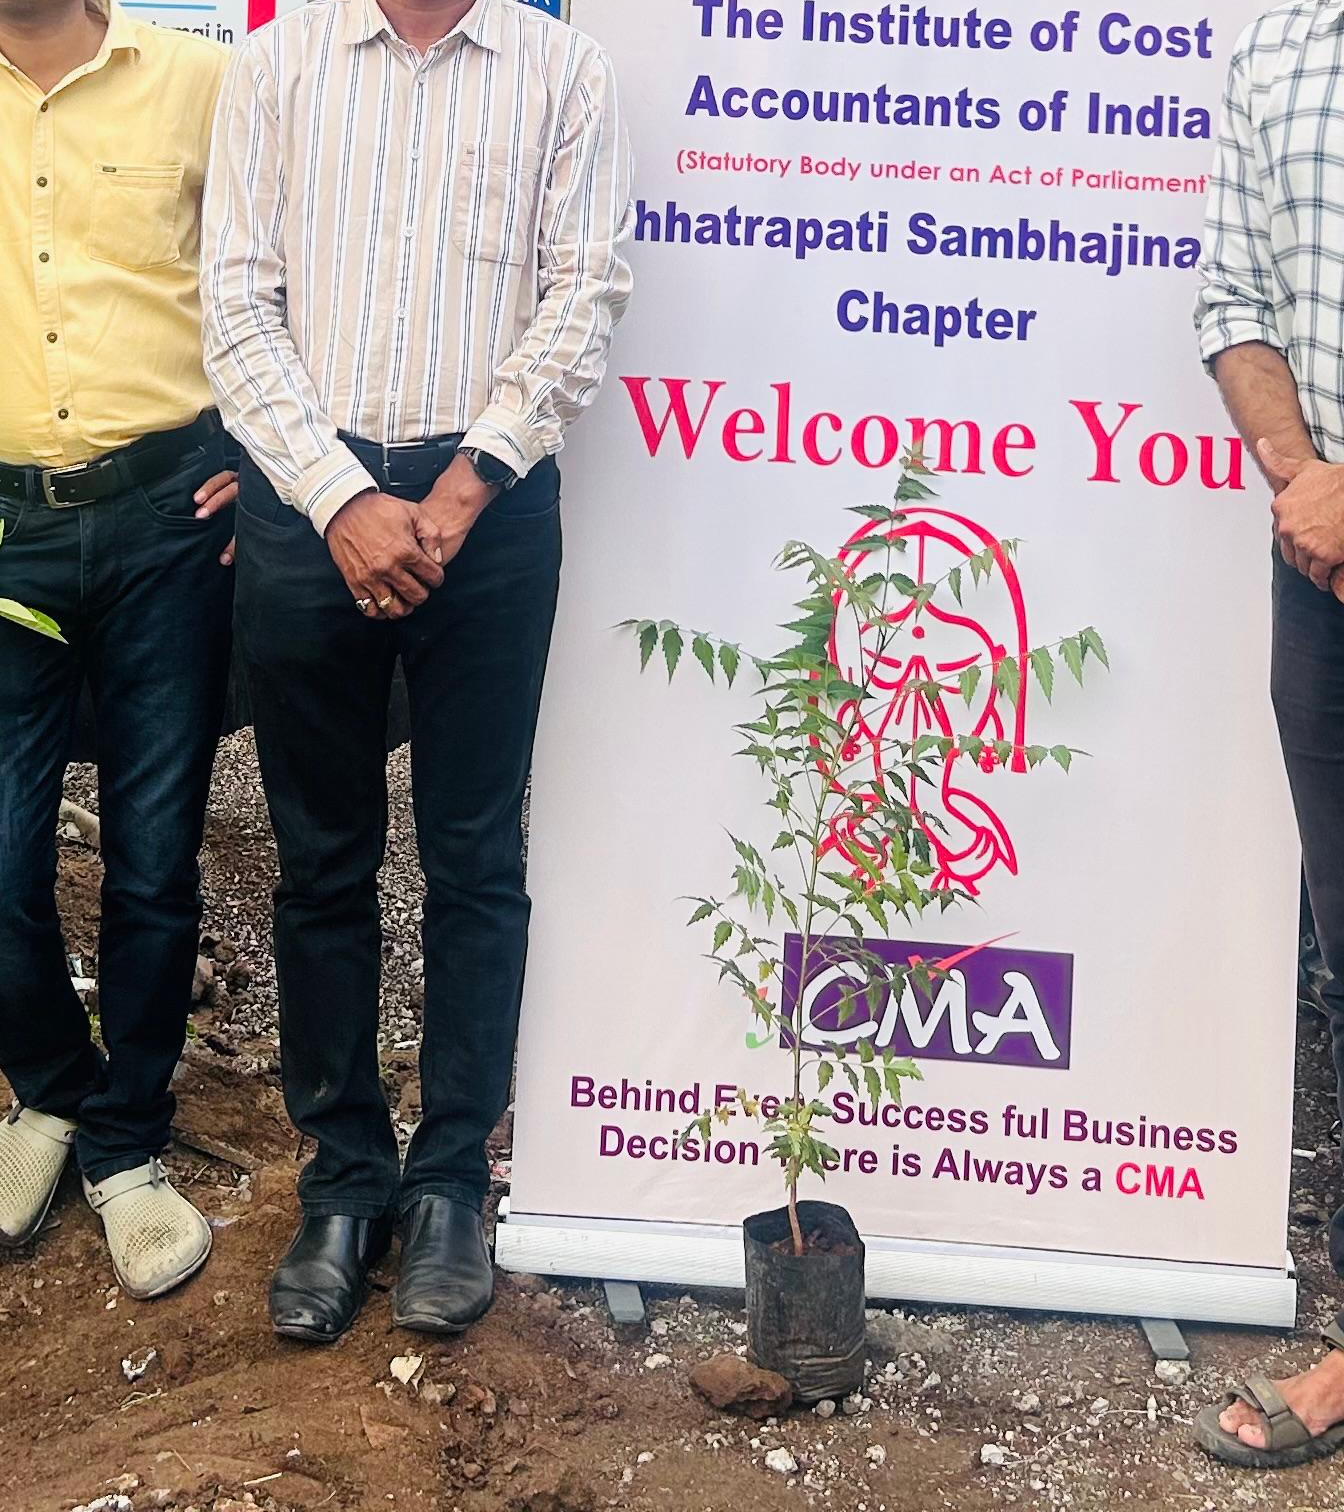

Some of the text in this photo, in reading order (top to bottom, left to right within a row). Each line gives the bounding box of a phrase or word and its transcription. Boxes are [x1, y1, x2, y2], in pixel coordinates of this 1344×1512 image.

[802, 0, 1013, 51] Institute
[1031, 10, 1079, 54] of
[1098, 12, 1214, 60] Cost
[685, 74, 1212, 140] Accountants of India
[675, 148, 793, 178] (Statutory
[800, 155, 861, 183] Body
[869, 160, 942, 183] under
[949, 167, 981, 185] an
[989, 164, 1033, 187] Act
[1040, 168, 1065, 188] of
[635, 200, 1201, 277] hhatrapati Sambhajina
[836, 289, 1038, 347] Chapter
[620, 375, 1247, 491] Welcome You
[570, 1076, 1238, 1155] Behind Success ful Business
[599, 1125, 759, 1167] Decision
[892, 1144, 922, 1178] is
[933, 1148, 1068, 1194] Always
[1082, 1167, 1102, 1192] a
[1116, 1162, 1205, 1201] CMA
